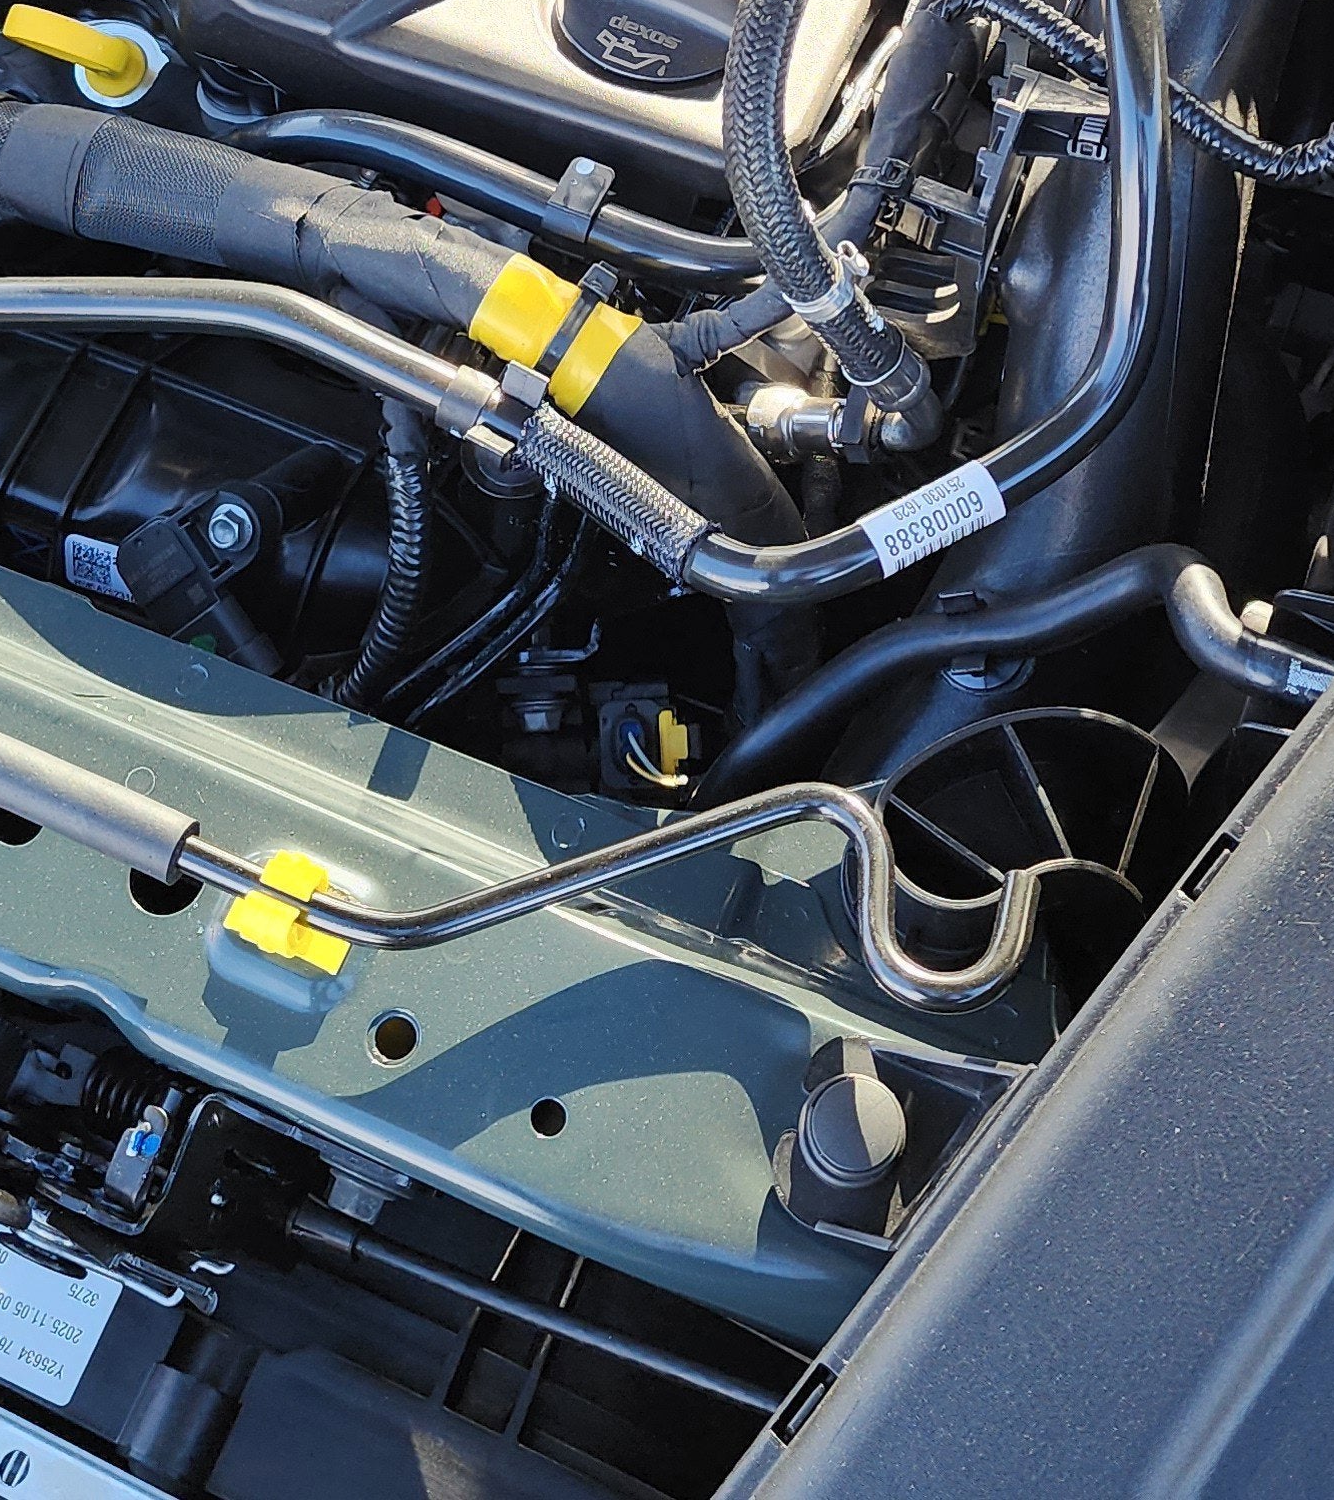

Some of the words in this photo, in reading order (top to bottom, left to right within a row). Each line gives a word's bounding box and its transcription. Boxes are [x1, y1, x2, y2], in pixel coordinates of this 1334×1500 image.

[609, 15, 682, 50] dexos
[921, 476, 966, 505] 251030
[884, 491, 984, 556] 60008388
[891, 498, 922, 521] 1629
[67, 1282, 100, 1307] 3275
[12, 1301, 83, 1344] 2025.11.05
[18, 1346, 65, 1380] Y25634
